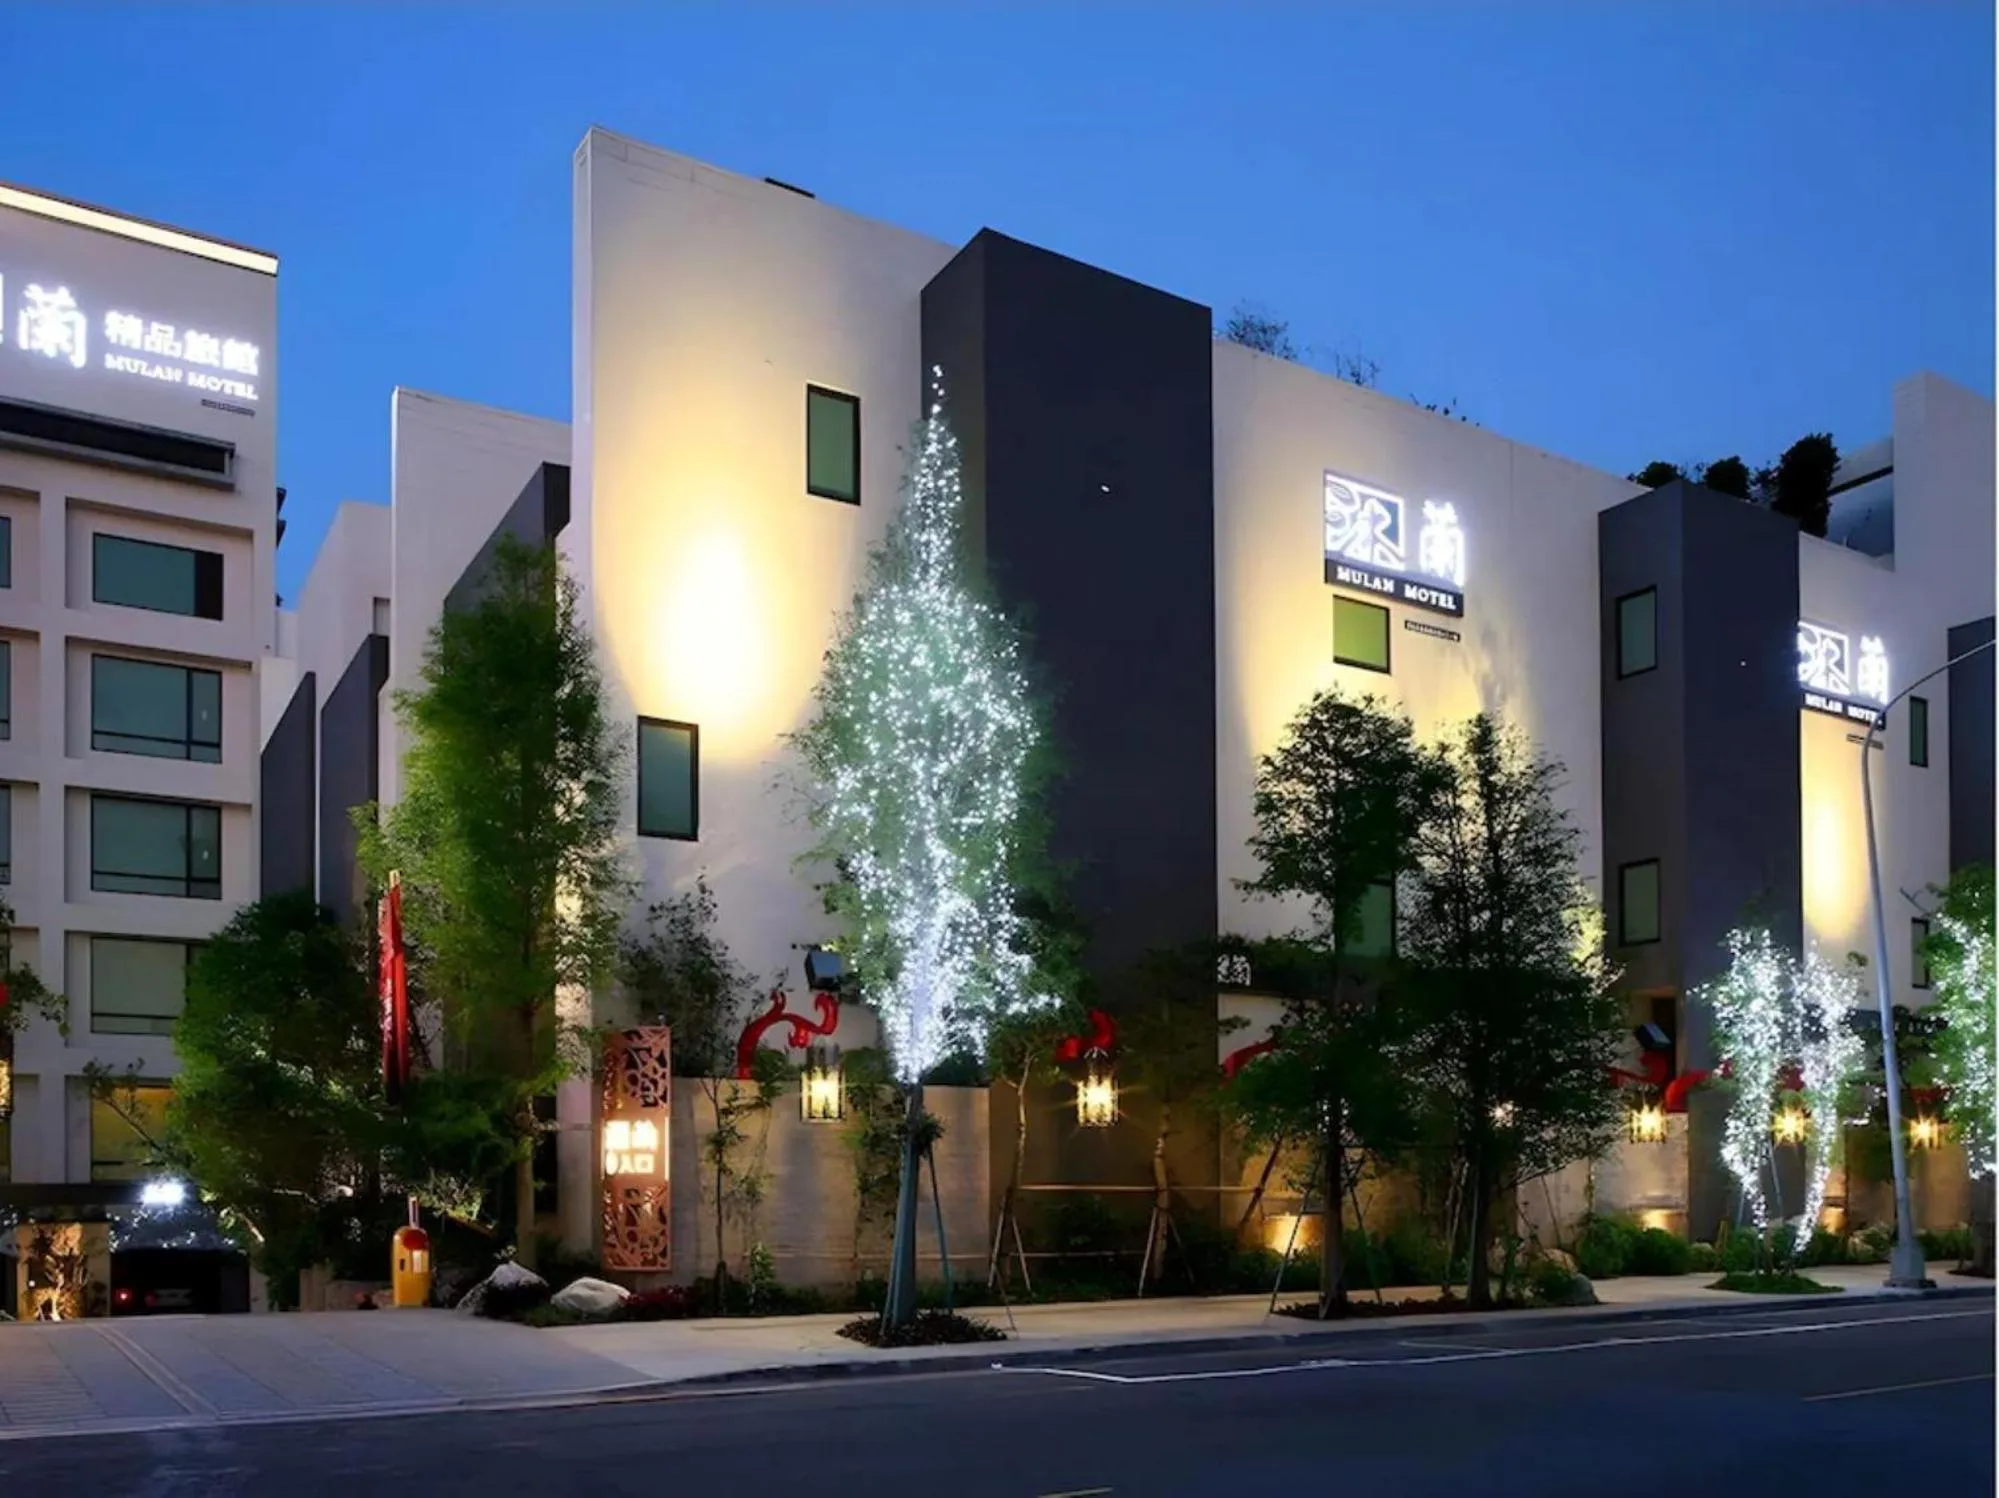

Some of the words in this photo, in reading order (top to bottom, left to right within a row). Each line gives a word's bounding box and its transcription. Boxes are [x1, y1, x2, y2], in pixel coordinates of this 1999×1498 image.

[105, 353, 183, 383] MULAN
[187, 370, 258, 400] MOTEL
[1336, 565, 1395, 593] MULAN
[1404, 583, 1456, 610] MOTEL
[1847, 705, 1882, 725] MOTE
